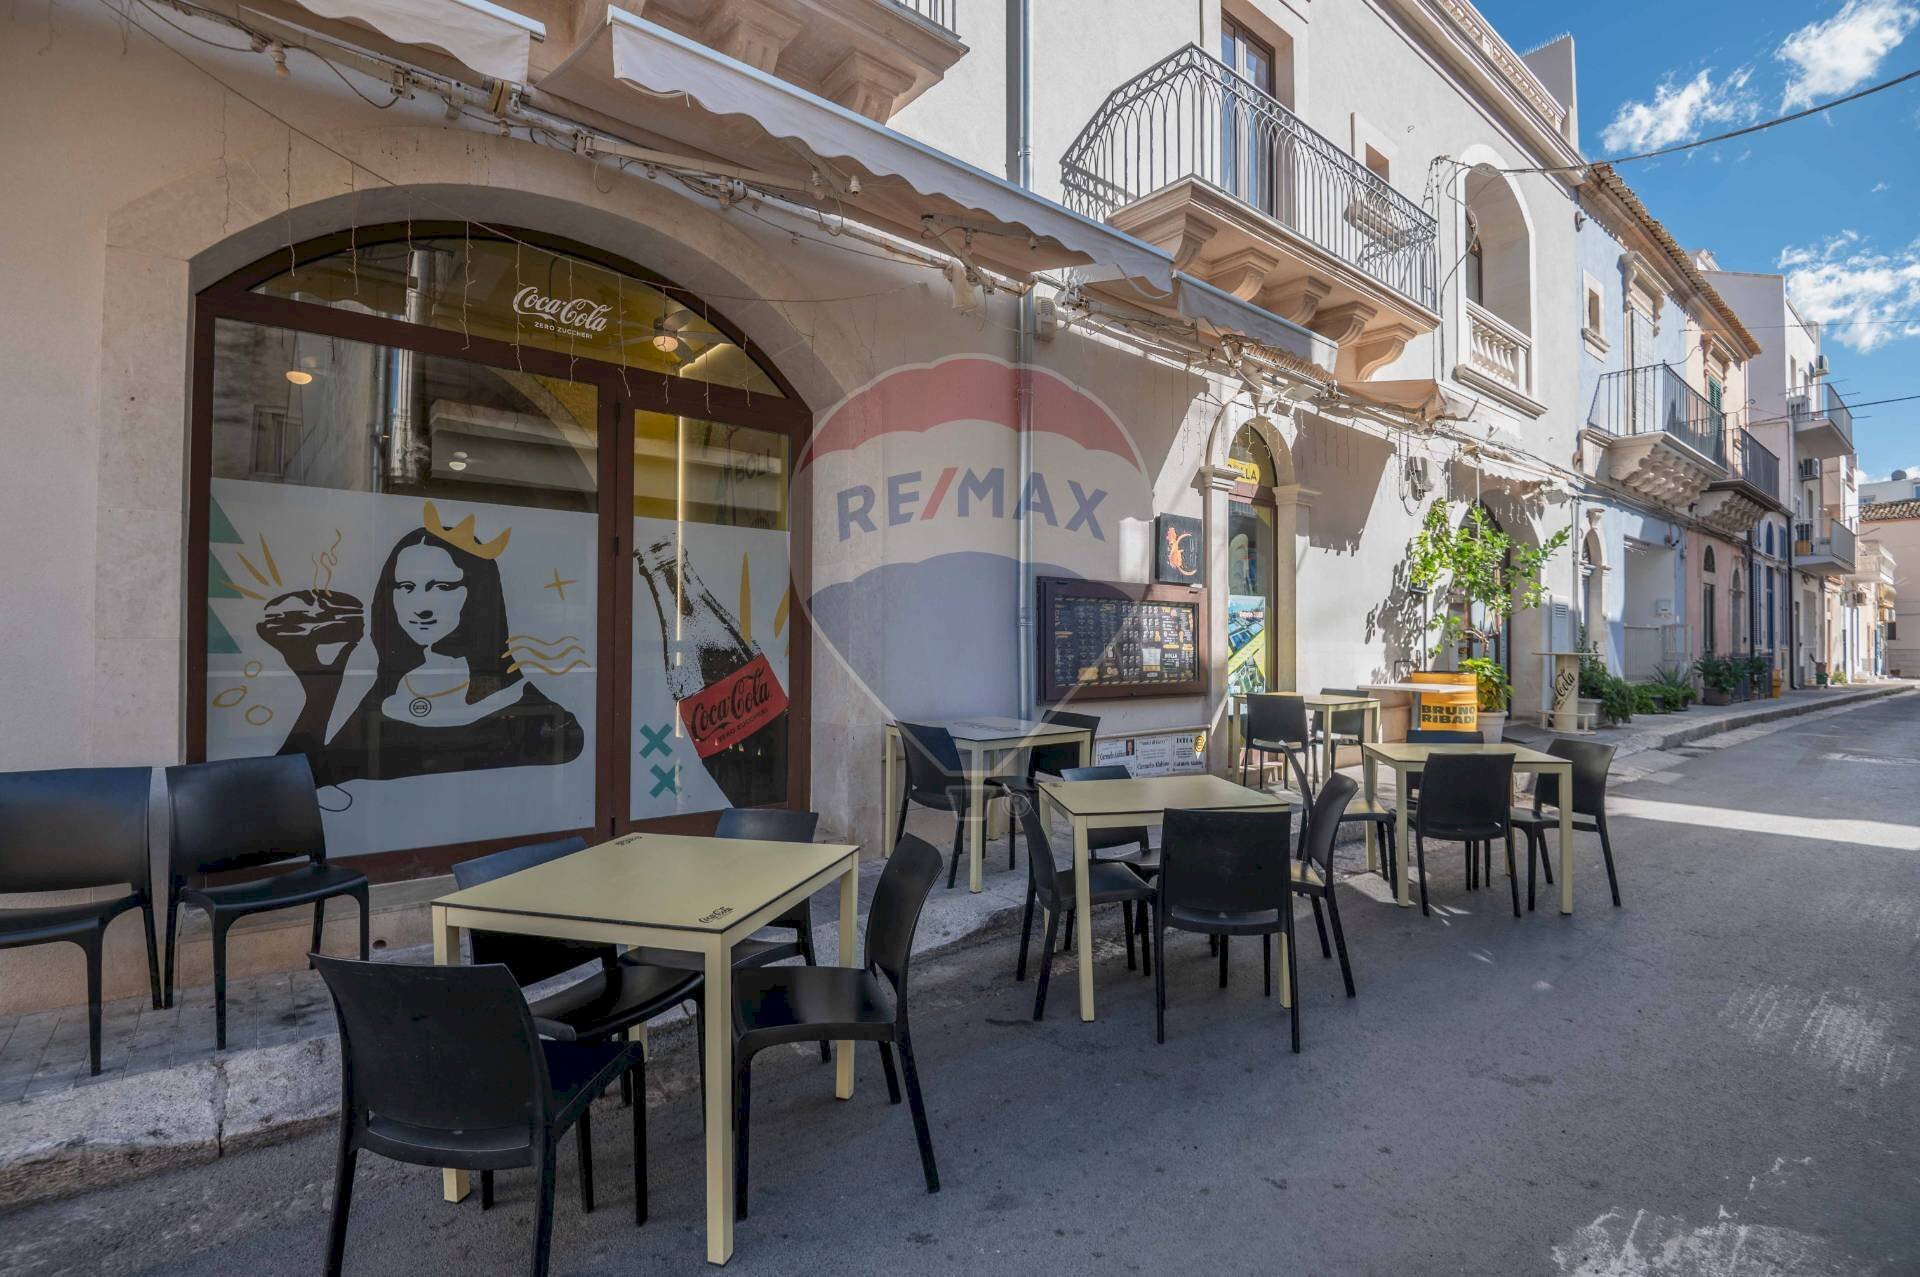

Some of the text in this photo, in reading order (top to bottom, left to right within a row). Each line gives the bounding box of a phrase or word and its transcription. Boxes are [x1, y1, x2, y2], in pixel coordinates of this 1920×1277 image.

[512, 286, 613, 332] Coca-Cola
[534, 322, 593, 340] ZERO ZUCCHERI
[691, 666, 771, 742] Coca-Cola
[1422, 704, 1475, 714] BRUNO
